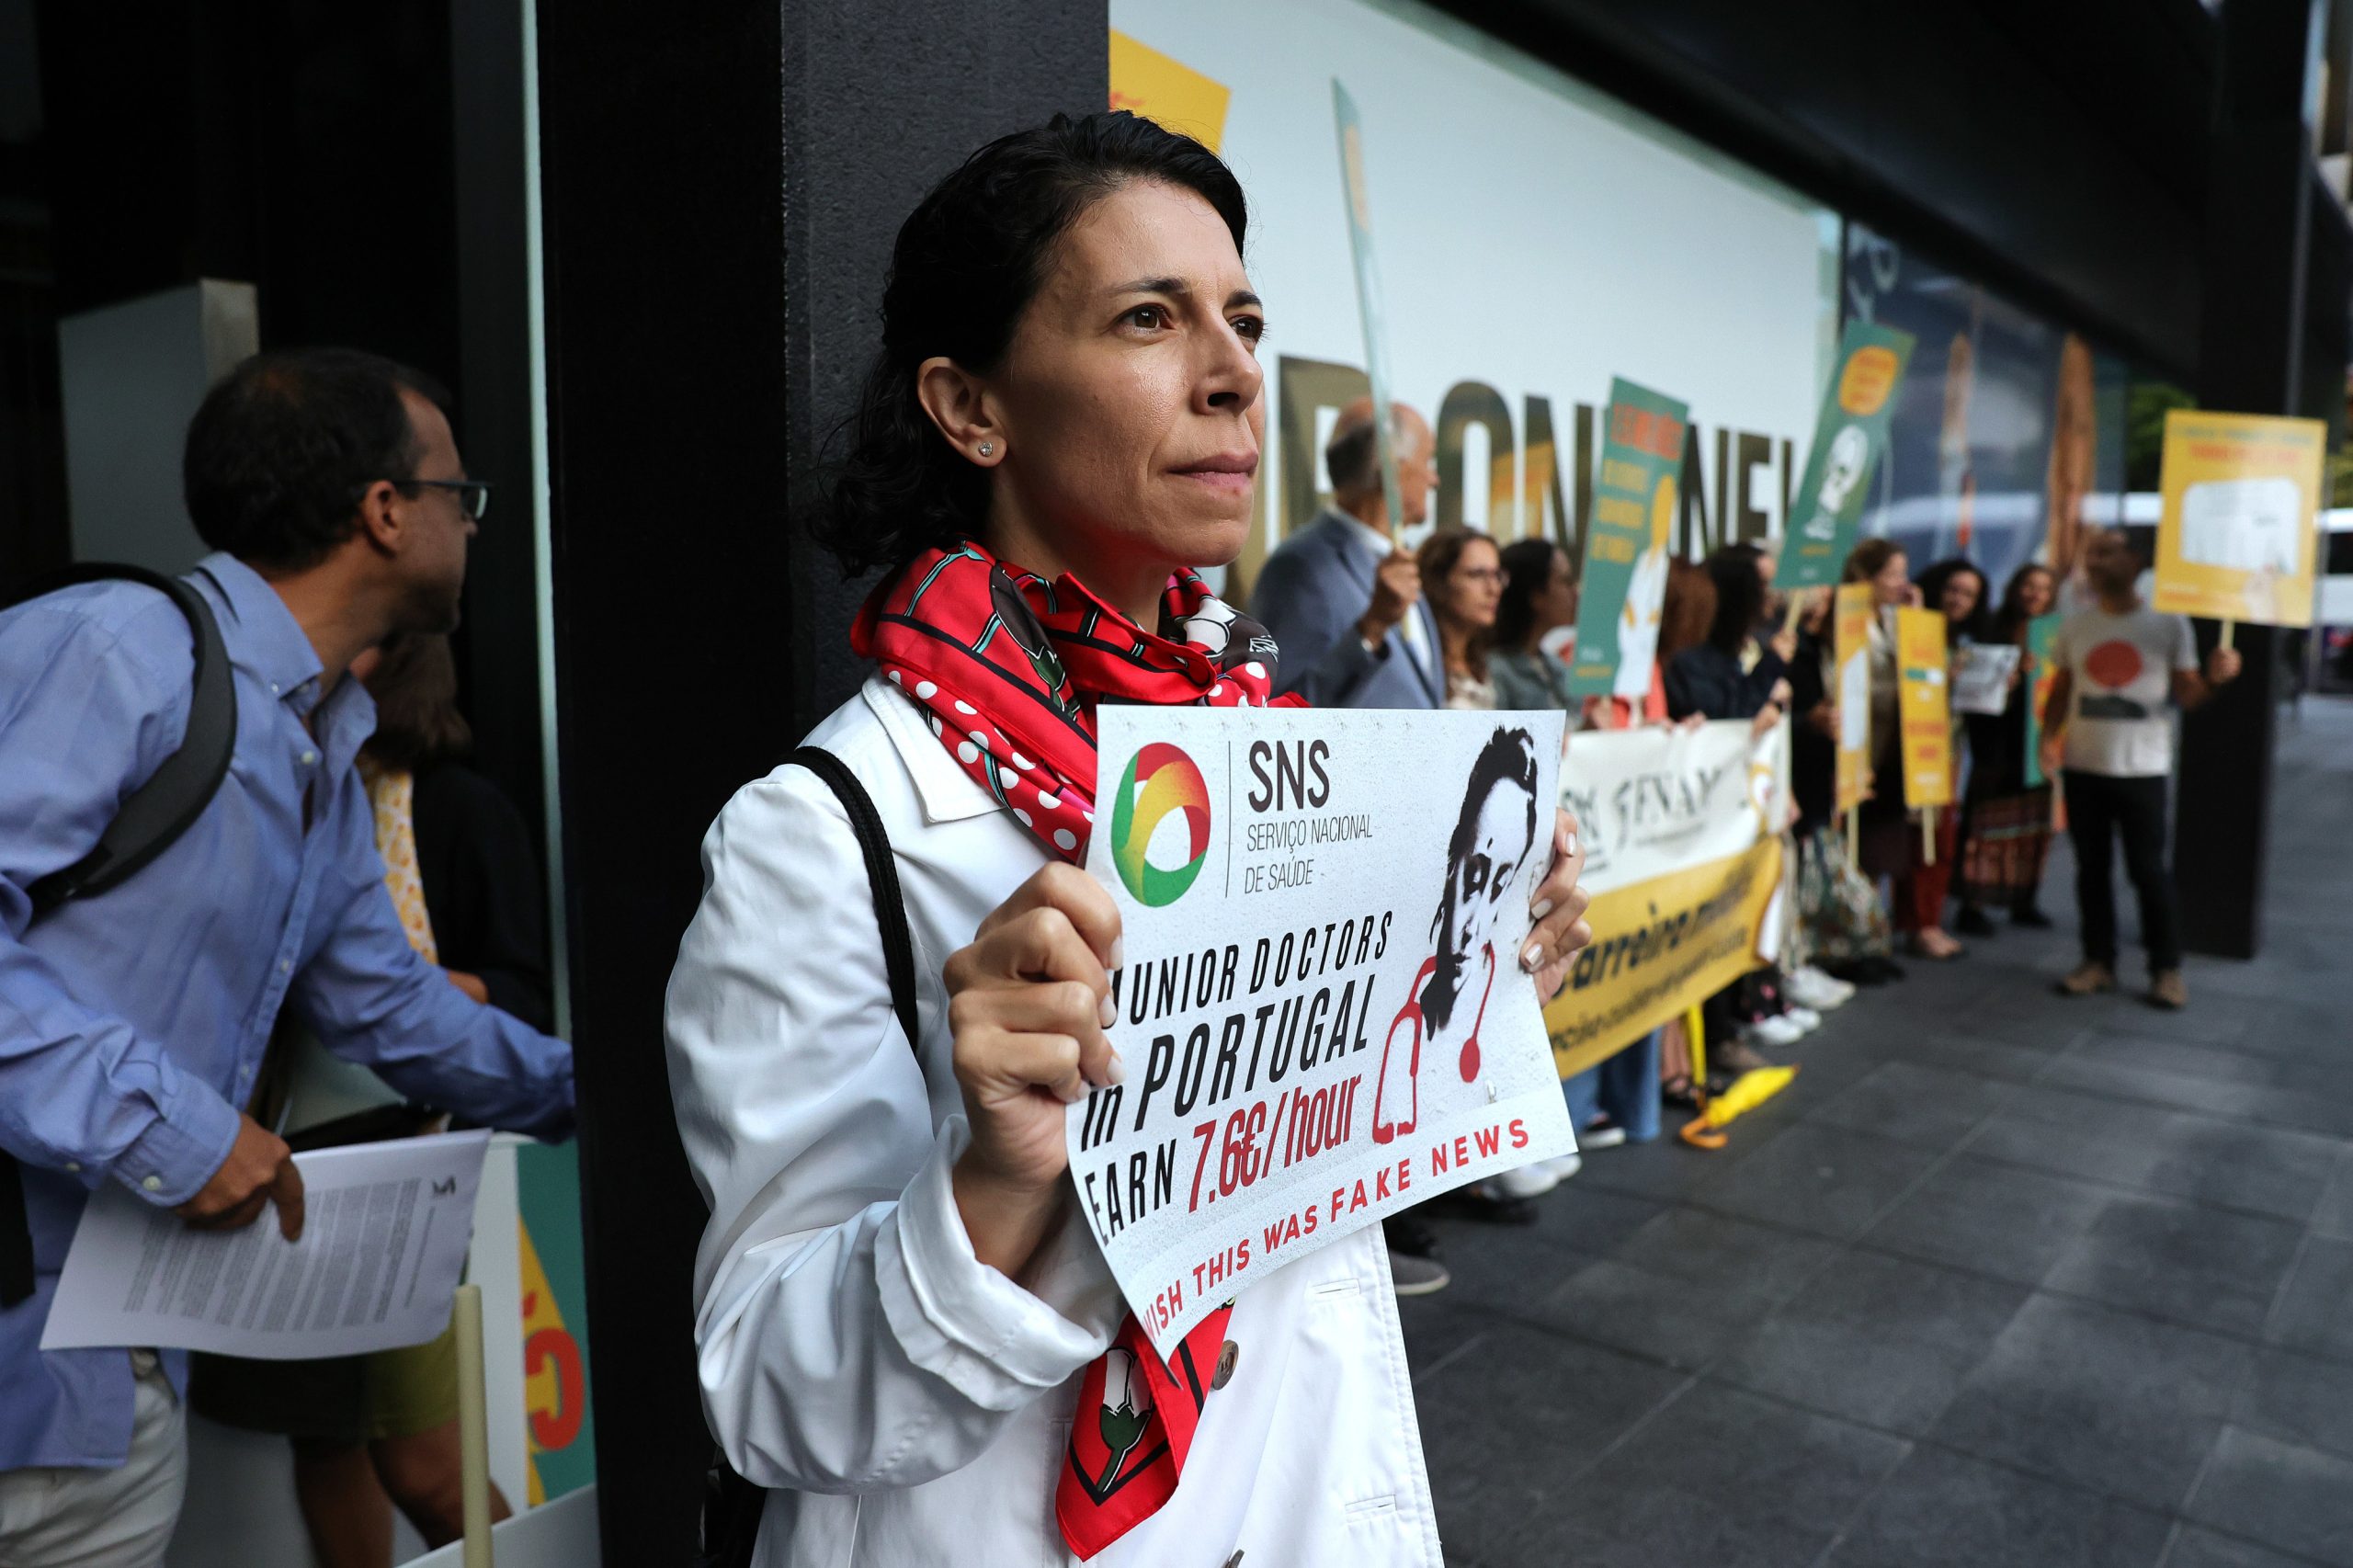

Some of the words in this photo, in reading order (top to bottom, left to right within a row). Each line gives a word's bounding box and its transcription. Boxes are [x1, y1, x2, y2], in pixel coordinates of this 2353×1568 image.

[1248, 739, 1330, 813] SNS
[1244, 865, 1266, 894] DE
[1267, 856, 1314, 891] SAÚDE
[1247, 819, 1307, 854] SERVIÇO
[1311, 813, 1373, 845] NACIONAL
[1248, 910, 1393, 994] DOCTORS
[1133, 973, 1376, 1132] PORTUGAL
[1085, 1138, 1177, 1247] EARN
[1193, 1238, 1250, 1298] THIS
[1263, 1204, 1318, 1255] WAS
[1330, 1157, 1411, 1223] FAKE
[1431, 1119, 1529, 1177] NEWS
